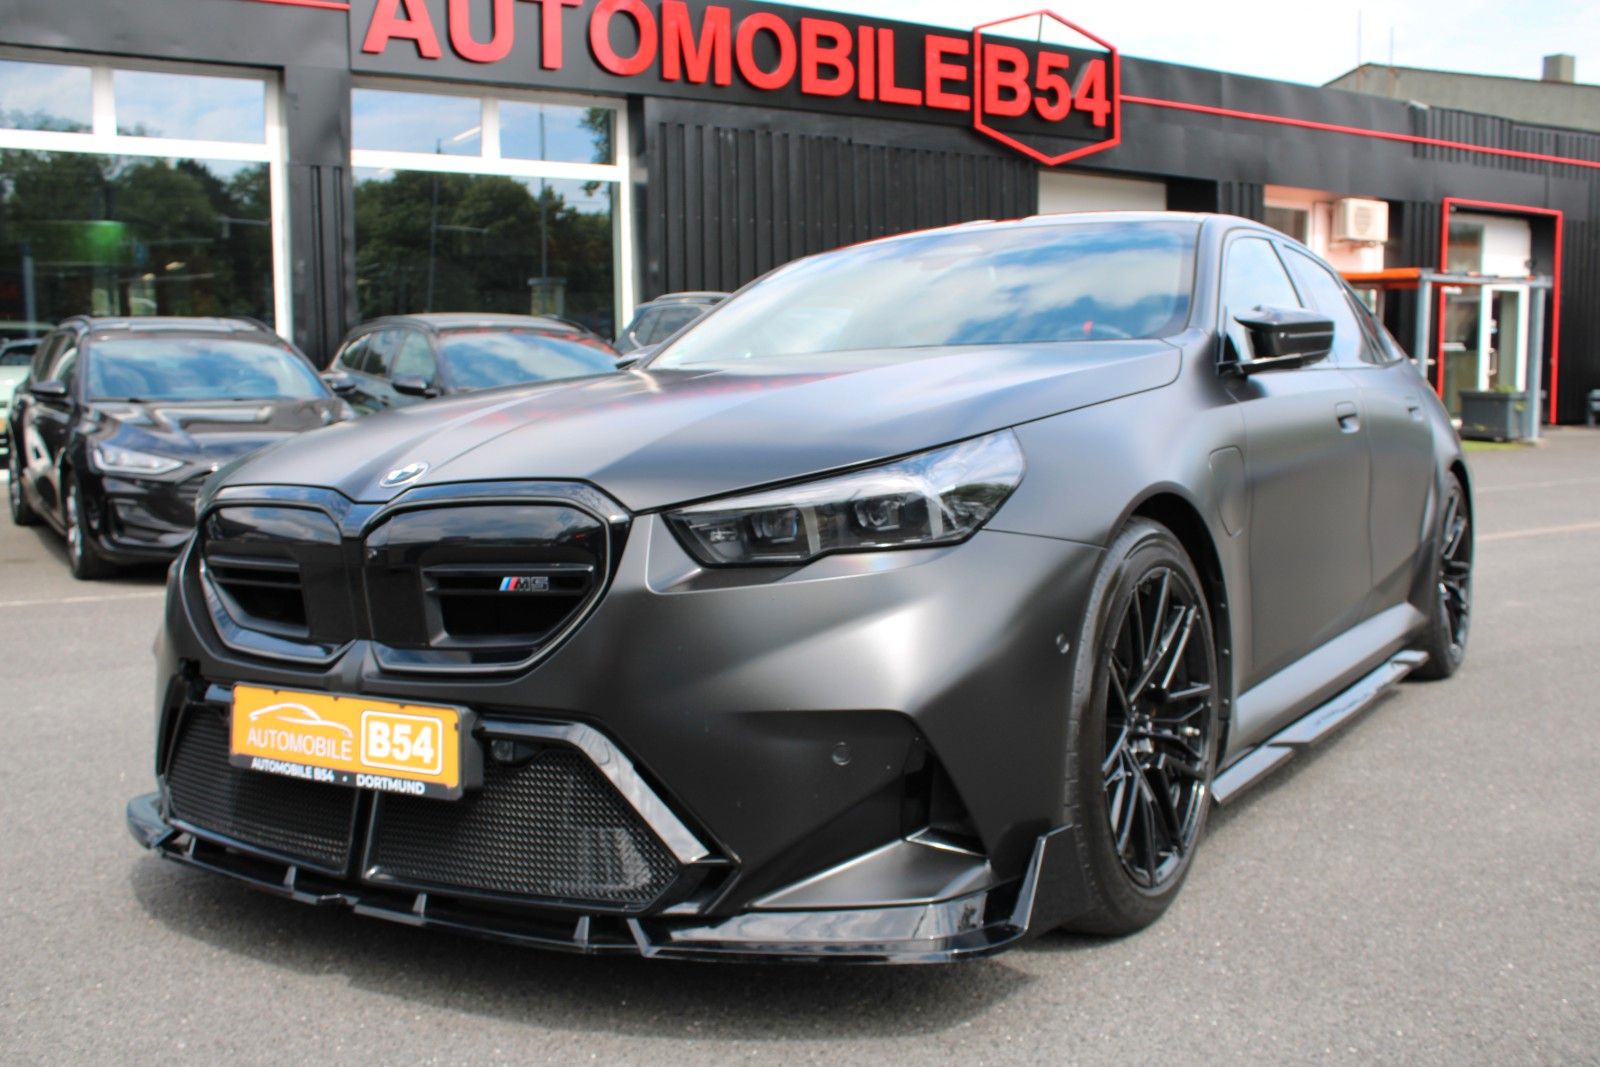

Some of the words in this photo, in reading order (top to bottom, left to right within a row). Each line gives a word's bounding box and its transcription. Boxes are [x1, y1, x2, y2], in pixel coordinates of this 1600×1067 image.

[362, 0, 971, 111] AUTOMOBILE
[983, 43, 1111, 126] B54
[246, 727, 353, 761] AUTOMOBILE
[368, 721, 434, 763] B54
[251, 757, 313, 779] AUTOMOBILE
[314, 769, 335, 783] B54
[356, 773, 426, 796] DORTMUND
